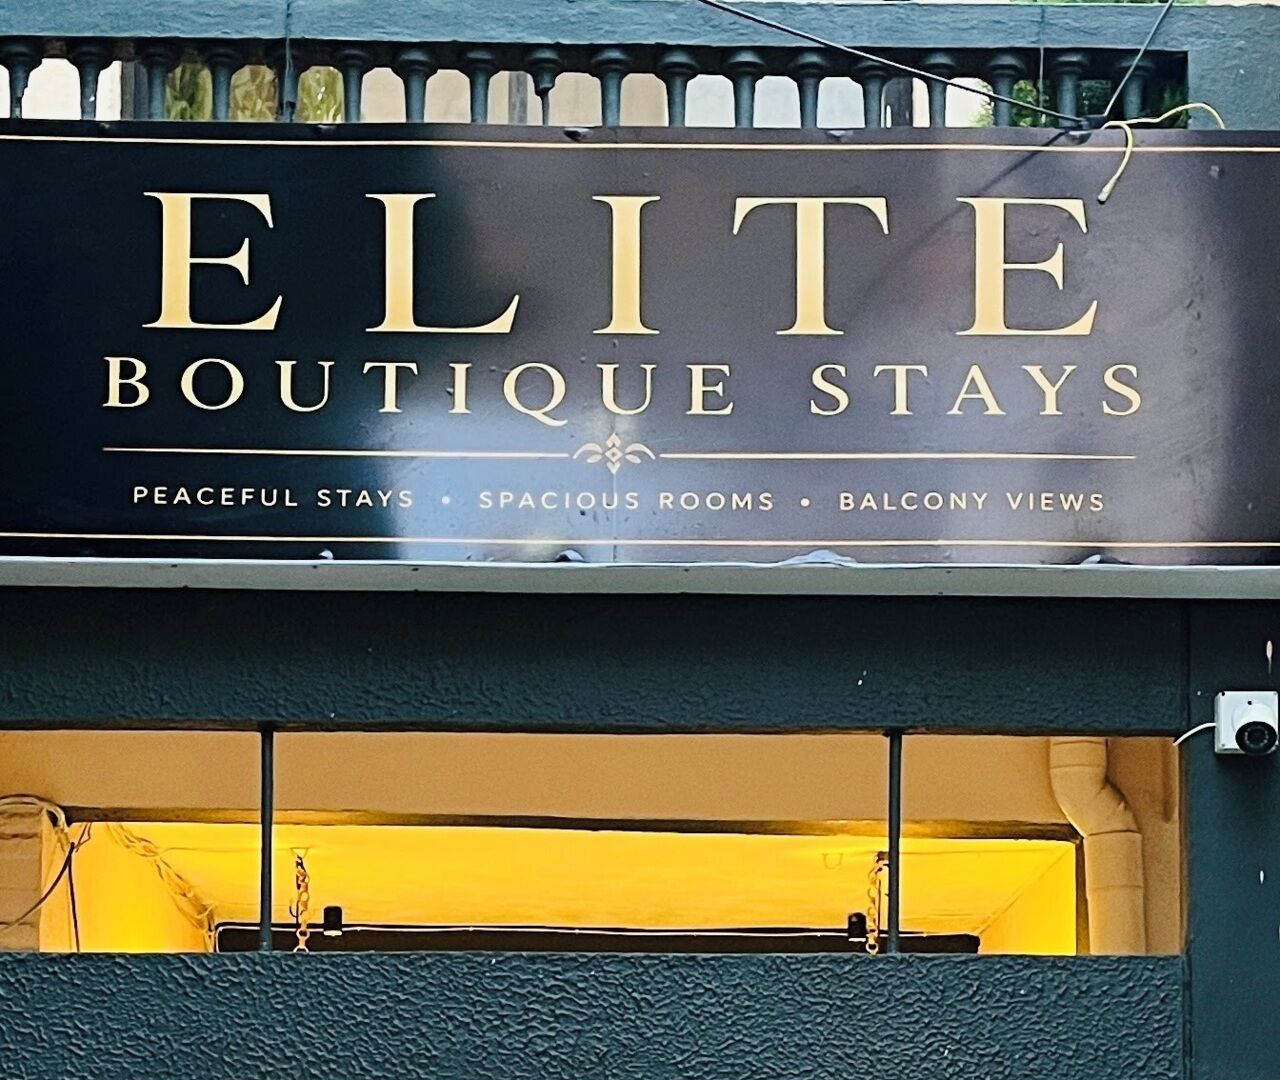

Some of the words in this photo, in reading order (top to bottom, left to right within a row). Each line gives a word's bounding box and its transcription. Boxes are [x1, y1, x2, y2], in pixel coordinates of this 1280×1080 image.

[141, 190, 1100, 338] ELITE
[101, 355, 735, 427] BOUTIQUE
[809, 362, 1142, 417] STAYS
[132, 485, 299, 508] PEACEFUL
[316, 488, 413, 509] STAYS
[478, 491, 640, 511] SPACIOUS
[658, 491, 775, 512] ROOMS
[838, 491, 989, 512] BALCONY
[1006, 491, 1105, 512] VIEWS
